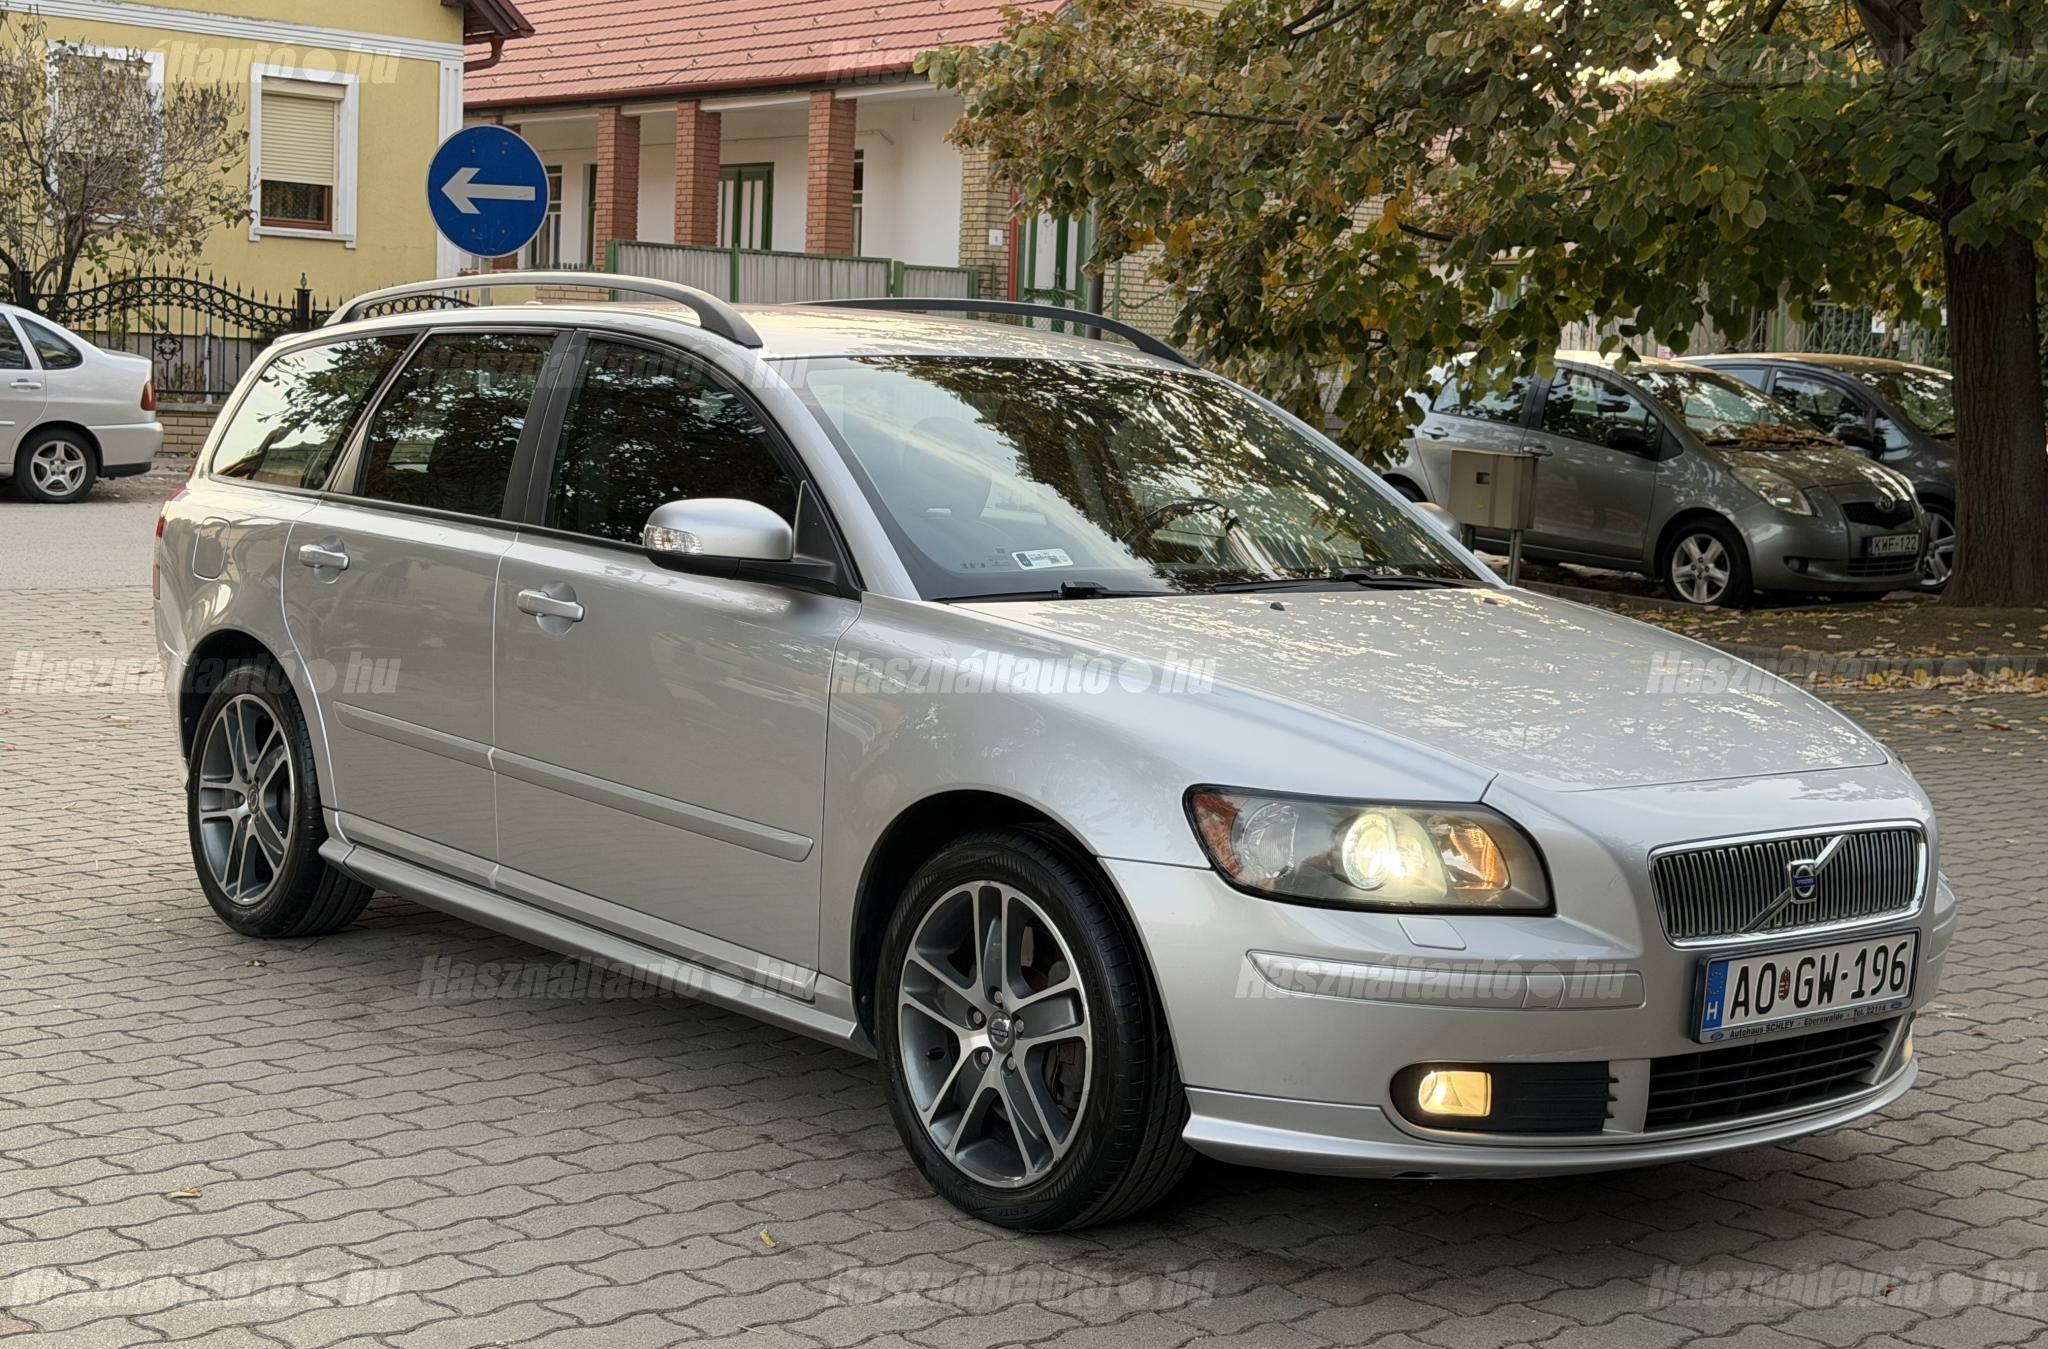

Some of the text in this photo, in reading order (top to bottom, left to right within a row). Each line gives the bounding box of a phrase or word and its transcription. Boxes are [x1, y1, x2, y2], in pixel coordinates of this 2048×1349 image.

[1794, 941, 1908, 1008] GW-196
[1706, 1001, 1718, 1021] H
[1729, 1026, 1763, 1039] Autohaus
[1765, 1020, 1794, 1033] SCHLEY
